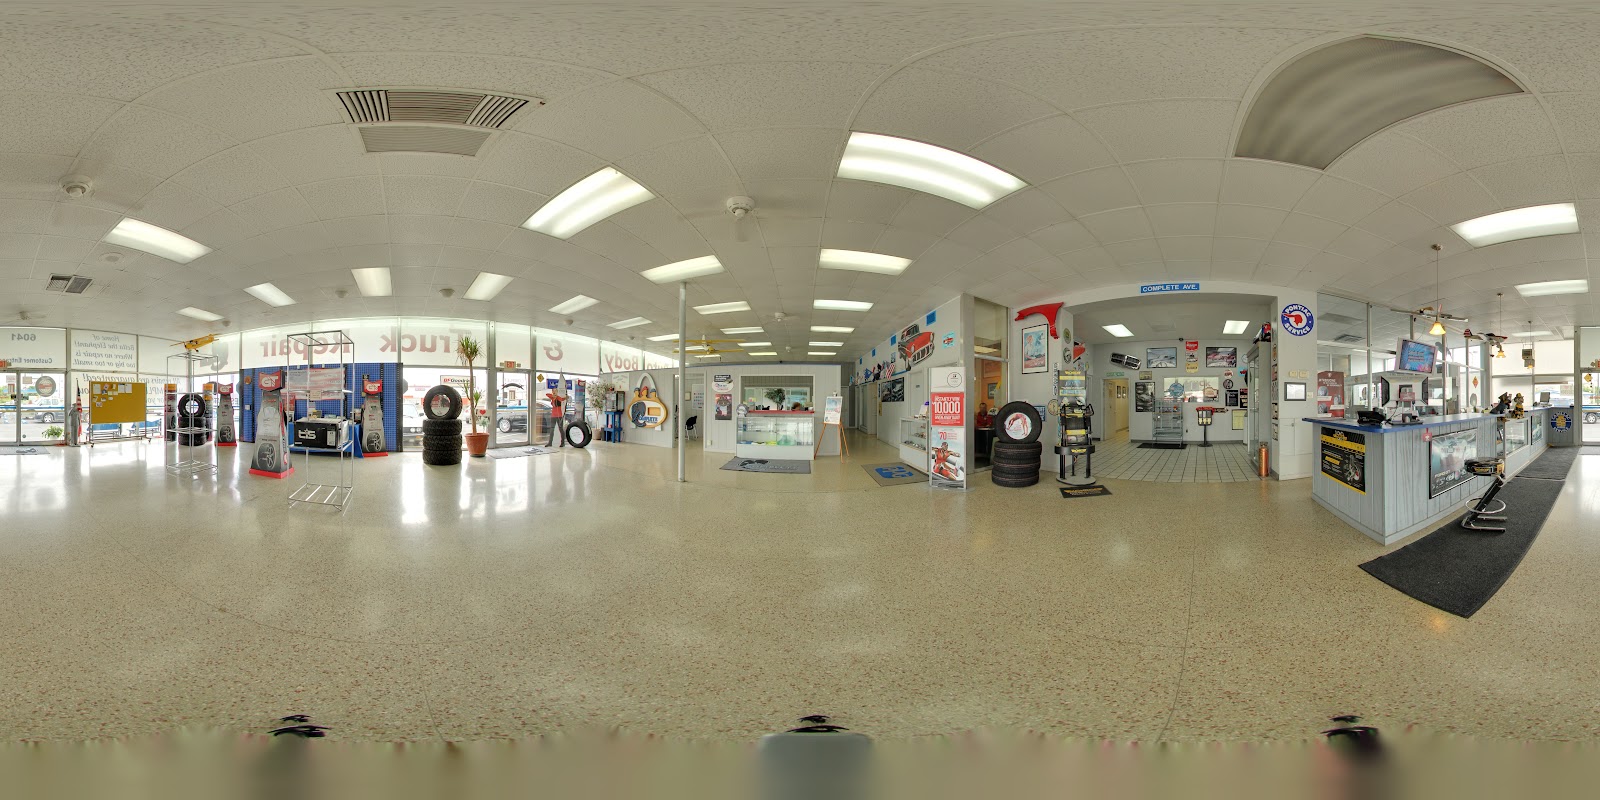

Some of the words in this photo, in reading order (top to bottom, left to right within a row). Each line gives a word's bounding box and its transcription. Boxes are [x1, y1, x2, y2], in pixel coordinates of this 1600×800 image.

[1142, 284, 1180, 292] COMPLETE
[1285, 304, 1311, 317] PONTIAC
[1284, 322, 1310, 335] SERVICE
